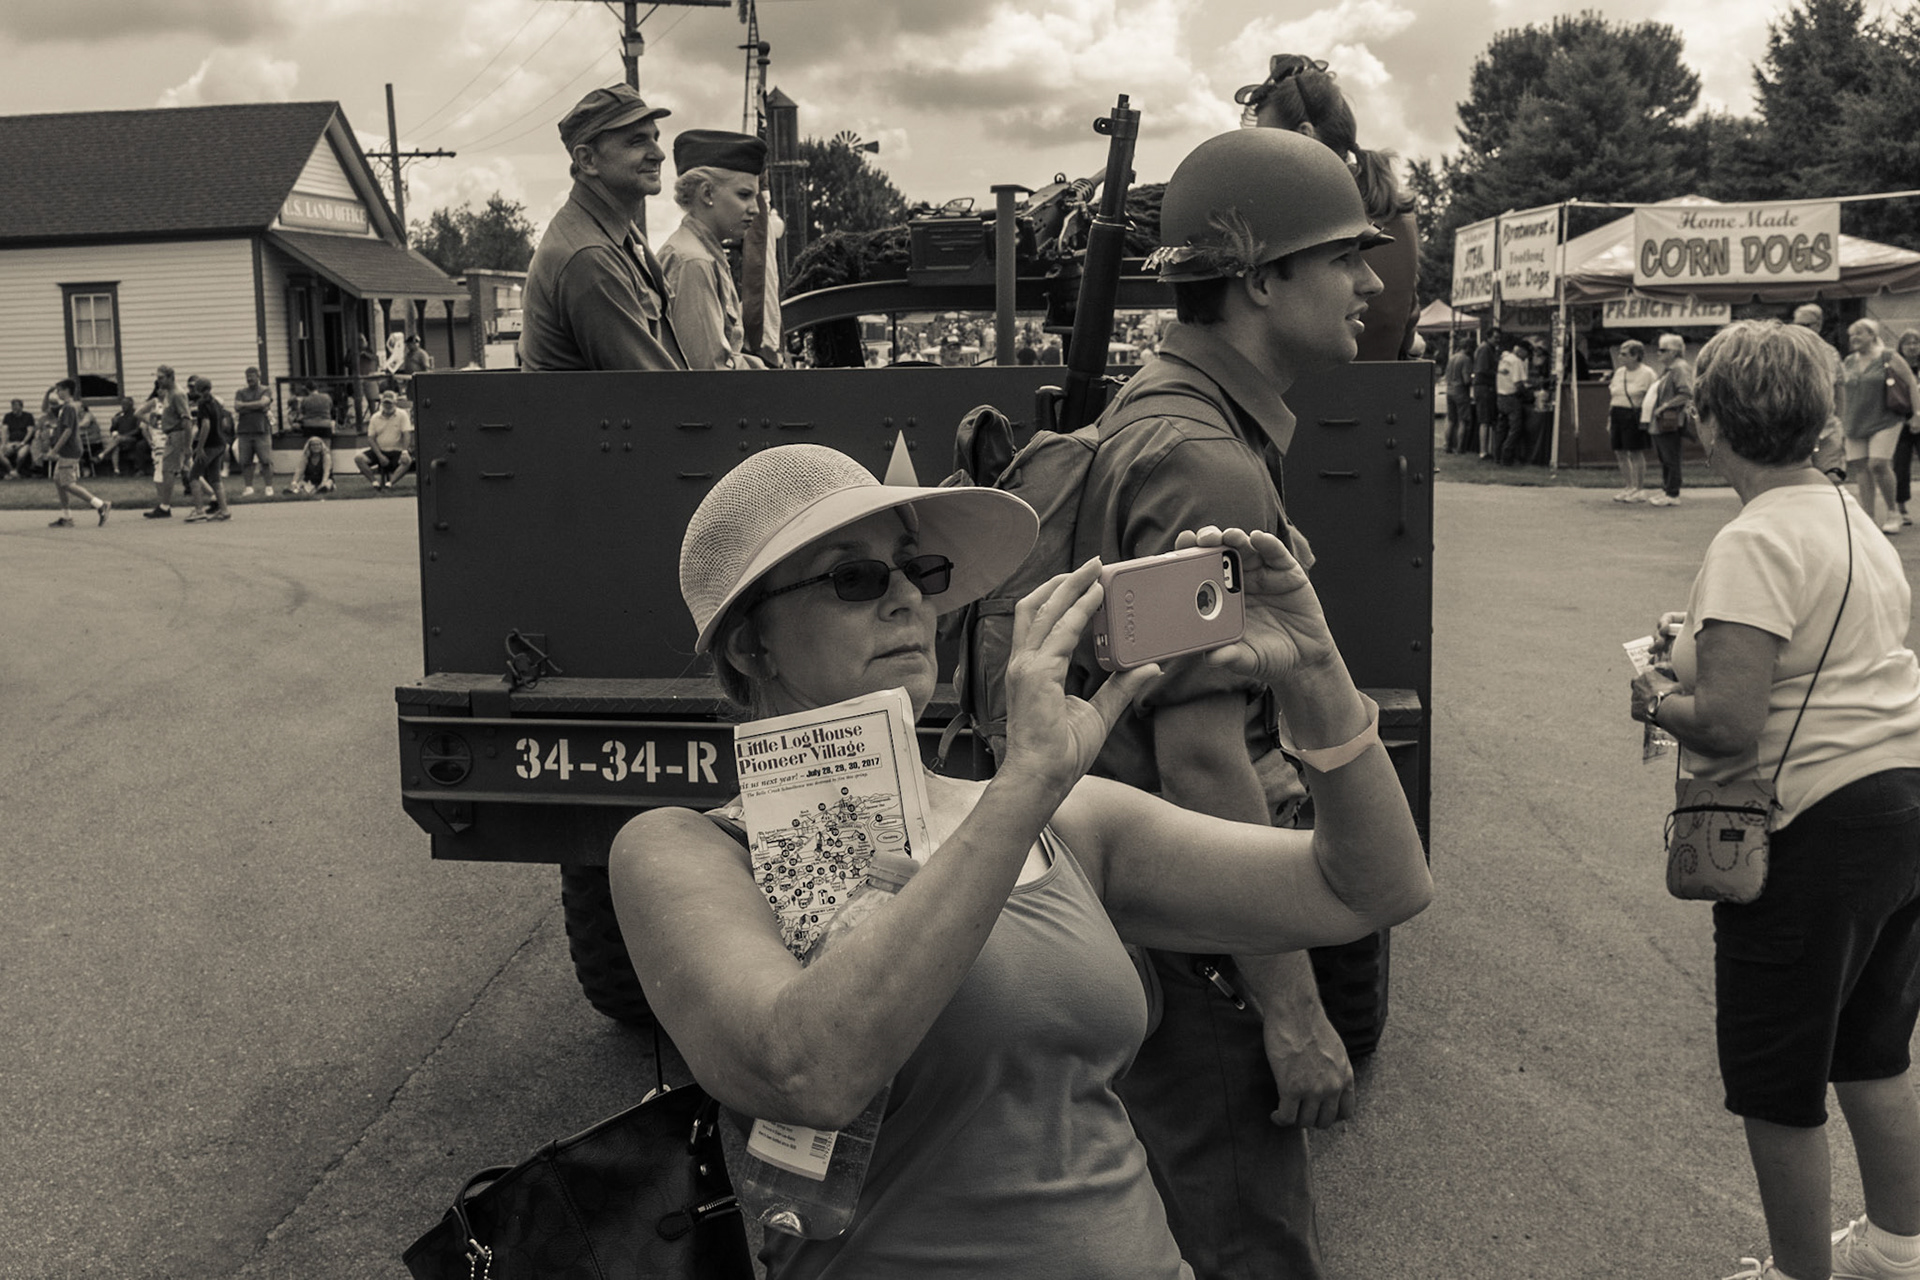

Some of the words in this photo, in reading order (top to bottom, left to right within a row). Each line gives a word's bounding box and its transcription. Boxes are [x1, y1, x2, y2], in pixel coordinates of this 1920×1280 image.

[305, 201, 334, 221] LAND
[335, 205, 367, 224] OFFICE
[1677, 210, 1736, 230] Home
[1739, 209, 1799, 228] Made
[1640, 237, 1730, 278] CORN
[1741, 232, 1833, 275] DOGS
[1505, 270, 1522, 288] Hot
[1525, 266, 1550, 292] Dogs
[1605, 299, 1673, 319] FRENCH
[737, 739, 779, 759] Little
[781, 731, 812, 751] Log
[812, 725, 863, 745] House
[516, 738, 719, 783] 34-34-R
[739, 750, 808, 775] Pioneer
[810, 740, 866, 762] Village
[761, 777, 778, 787] next
[779, 773, 799, 786] year!
[806, 768, 821, 779] July
[862, 757, 880, 768] 2017
